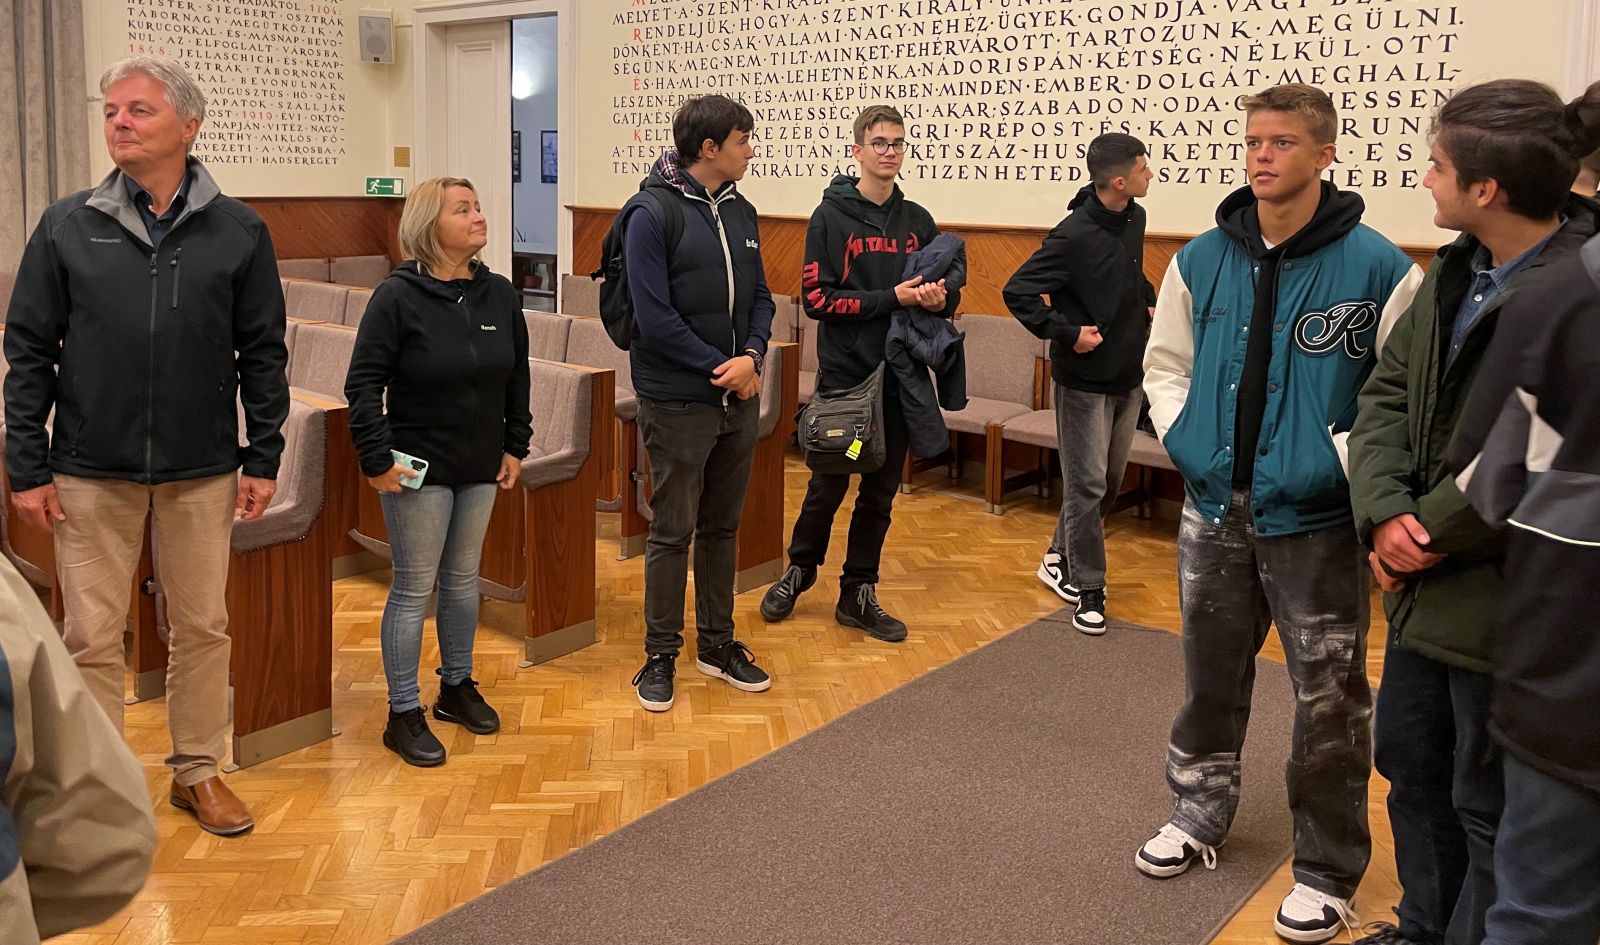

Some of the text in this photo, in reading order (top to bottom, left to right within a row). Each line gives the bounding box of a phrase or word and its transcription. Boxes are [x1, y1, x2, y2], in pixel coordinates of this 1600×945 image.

[127, 6, 220, 25] TÁBORNAGY
[207, 4, 276, 19] SIEGBERT
[287, 14, 344, 27] OSZTRÁK
[612, 8, 671, 25] MELYET
[678, 7, 688, 19] A
[697, 0, 752, 17] SZENT
[740, 14, 789, 31] HOGY
[797, 12, 810, 26] A
[821, 3, 889, 25] SZENT
[128, 20, 216, 35] KURUCOKKAL
[227, 28, 240, 38] ÉS
[248, 31, 299, 44] MÁSNAP
[684, 41, 704, 54] HA
[711, 36, 758, 52] CSAK
[764, 29, 841, 47] VALAMI
[850, 23, 907, 41] NAGY
[912, 12, 989, 36] NEHÉZ
[998, 9, 1077, 30] ÜGYEK
[1087, 0, 1207, 24] GONDJA
[128, 32, 155, 42] NUL
[167, 36, 184, 45] AZ
[196, 38, 272, 53] ELFOGLALT
[613, 59, 678, 75] SÉGÜNK
[683, 57, 719, 72] MEG
[724, 54, 762, 69] NEM
[770, 50, 809, 66] TILT
[896, 33, 1055, 58] FEHÉRVÁROTT
[1066, 21, 1252, 48] TARTOZUNK
[1267, 7, 1464, 36] MEGÜLNI.
[178, 48, 273, 64] JELLASCHICH
[656, 77, 676, 90] HA
[679, 76, 700, 89] MI
[707, 73, 735, 88] OTT
[741, 72, 780, 86] NEM
[904, 64, 917, 78] A
[922, 51, 1082, 77] NÁDORISPÁN
[1096, 43, 1202, 70] KÉTSÉG
[1220, 36, 1361, 63] NÉLKÜL
[1383, 33, 1459, 55] OTT
[254, 64, 344, 80] TÁBORNOKOK
[210, 87, 283, 98] AUGUSZTUS
[613, 95, 663, 108] LESZEN
[755, 87, 772, 103] ÉS
[777, 89, 788, 102] A
[793, 88, 814, 103] MI
[823, 82, 933, 103] KÉPÜNKBEN
[939, 79, 1023, 97] MINDEN
[1034, 75, 1125, 95] EMBER
[1136, 65, 1262, 91] DOLGÁT
[204, 98, 266, 109] SAPATOK
[655, 109, 671, 125] ÉS
[1000, 97, 1147, 117] SZABADON
[1163, 96, 1222, 113] ODA
[200, 131, 252, 141] HORTHY
[910, 123, 950, 141] GRI
[963, 116, 1085, 140] PRÉPOST
[195, 143, 251, 153] EVEZETI
[262, 145, 269, 153] A
[613, 145, 620, 158] A
[784, 140, 833, 159] UTÁN
[1365, 141, 1413, 163] ES
[613, 161, 651, 174] TEND
[916, 164, 1082, 182] TIZENHETED
